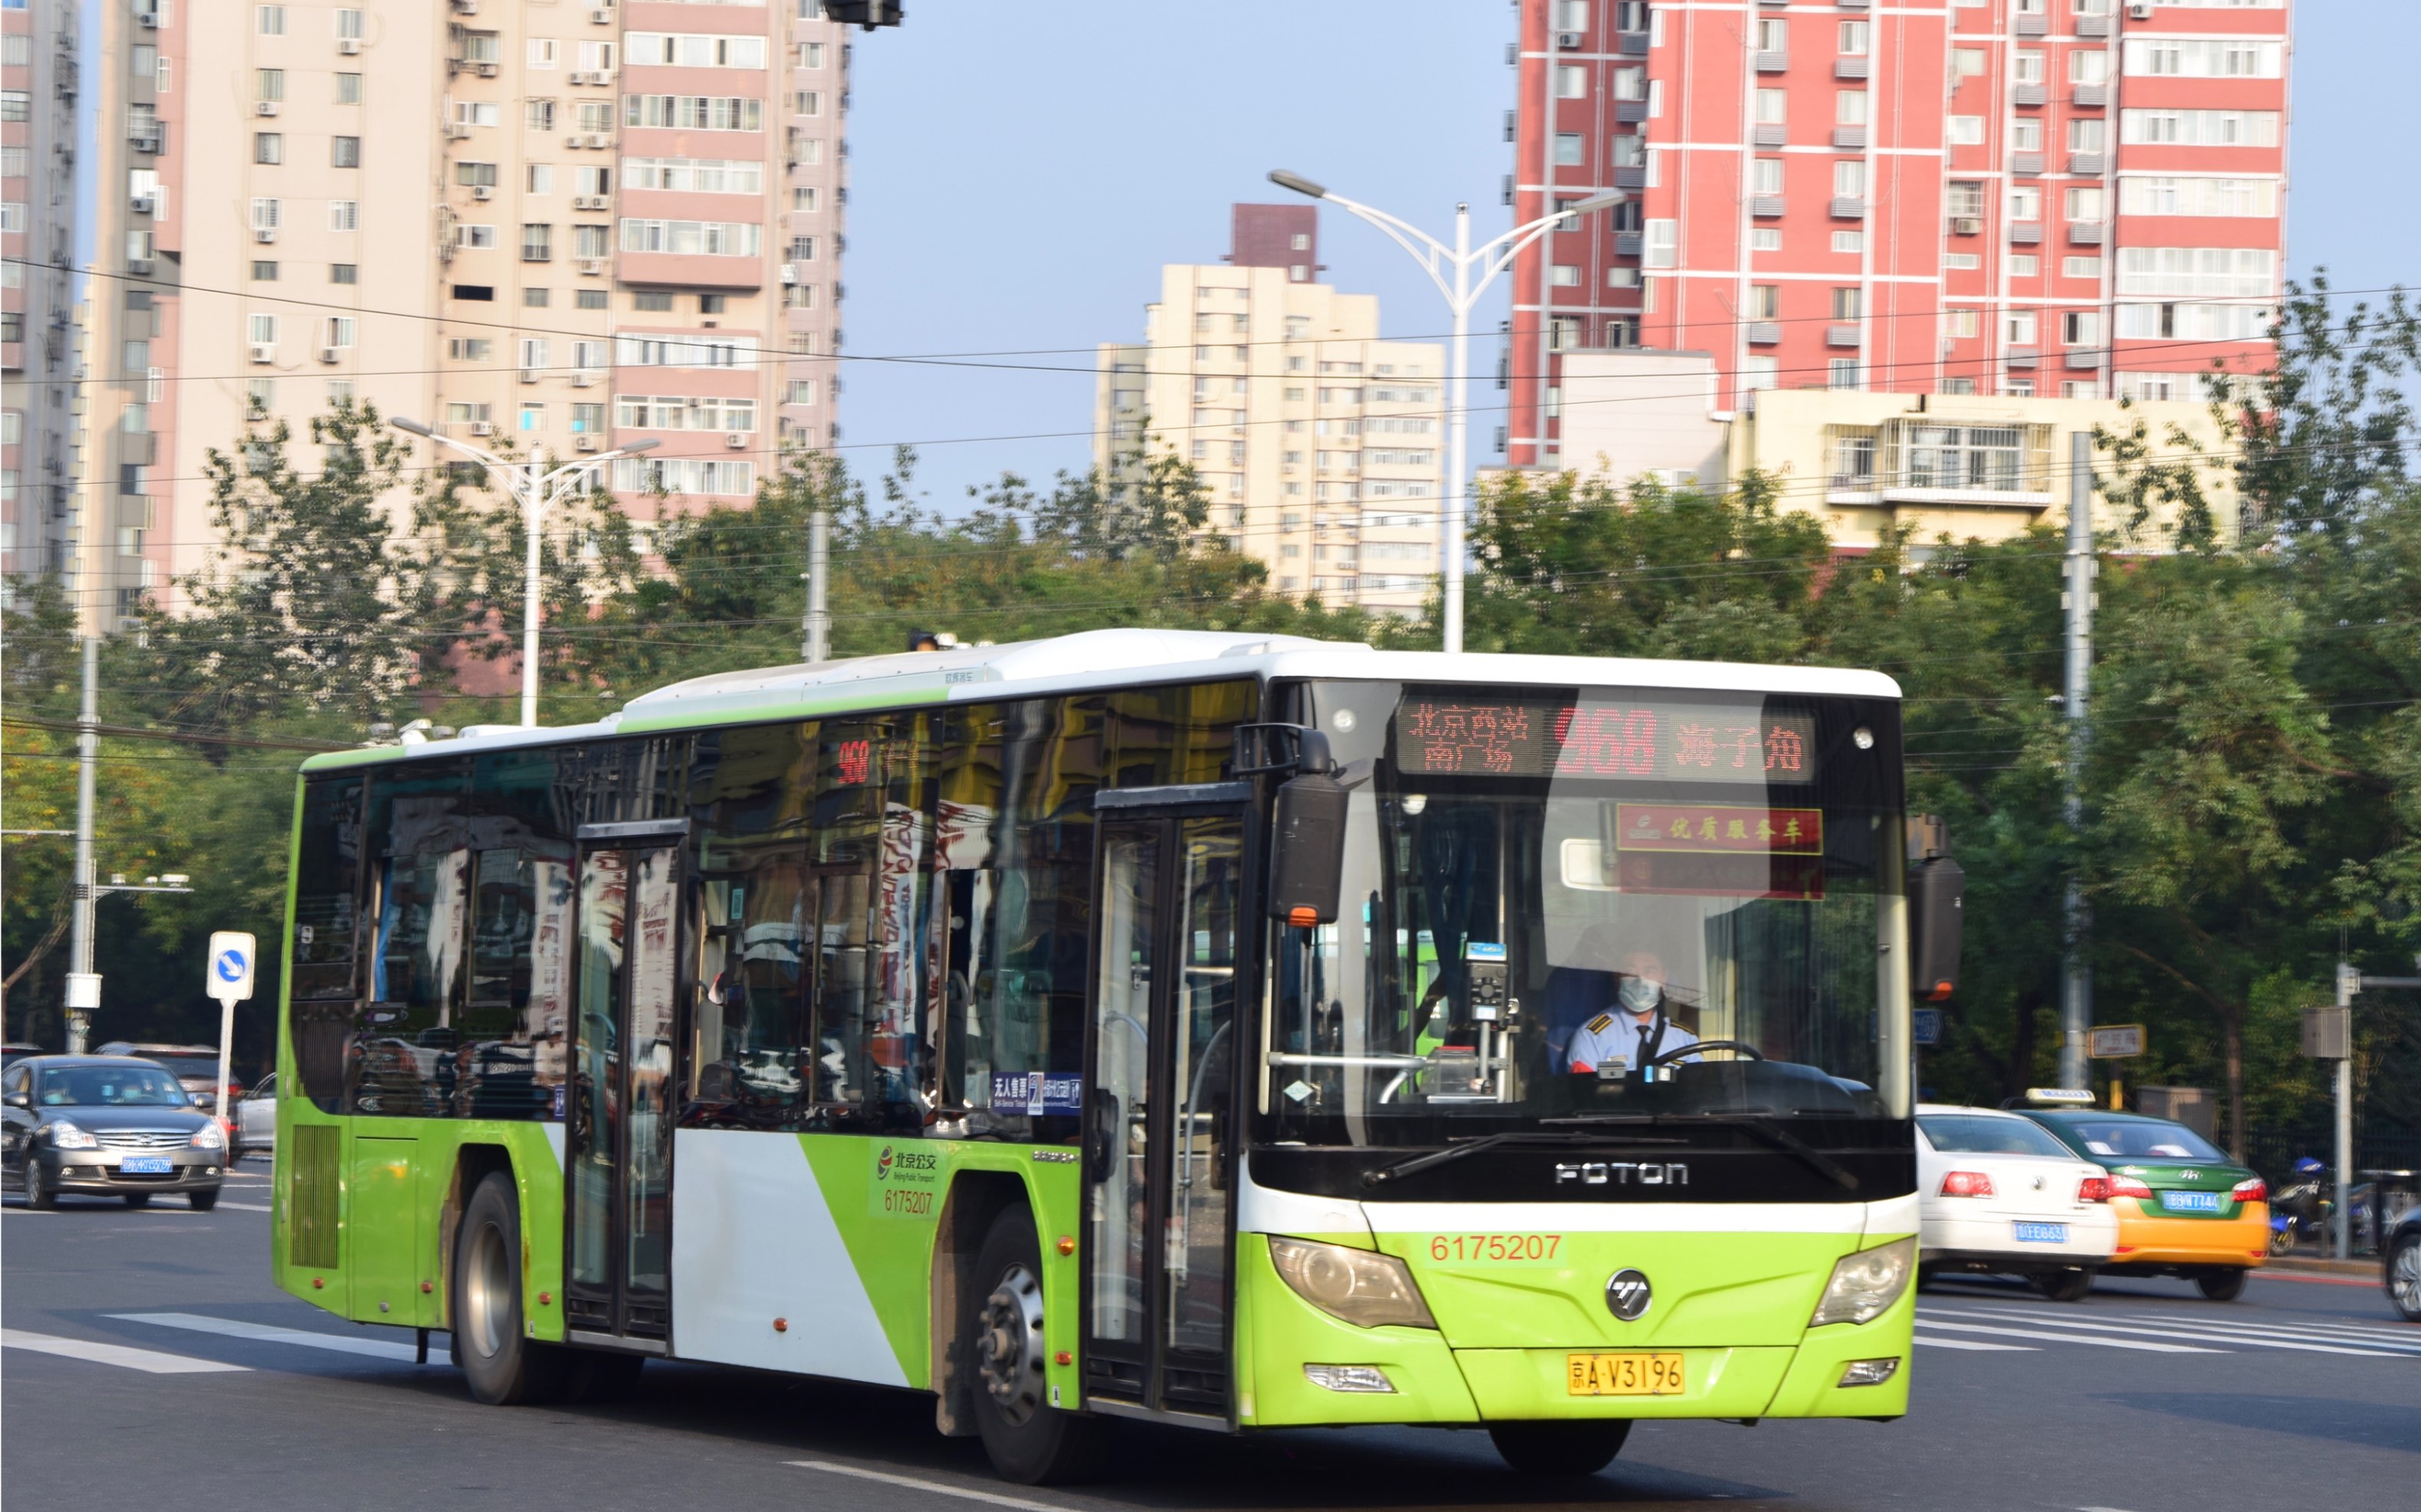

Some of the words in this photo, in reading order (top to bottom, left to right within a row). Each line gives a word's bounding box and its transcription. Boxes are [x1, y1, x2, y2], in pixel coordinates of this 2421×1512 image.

[1409, 703, 1528, 739] 北京西站
[1555, 707, 1656, 774] 968
[1424, 736, 1513, 772] 南广场
[1669, 816, 1803, 845] 优质服务车
[994, 1077, 1027, 1098] 无人售票
[895, 1153, 936, 1170] 北京公交
[1556, 1163, 1688, 1184] FOTON
[885, 1189, 933, 1214] 6175207
[1431, 1235, 1562, 1260] 6175207
